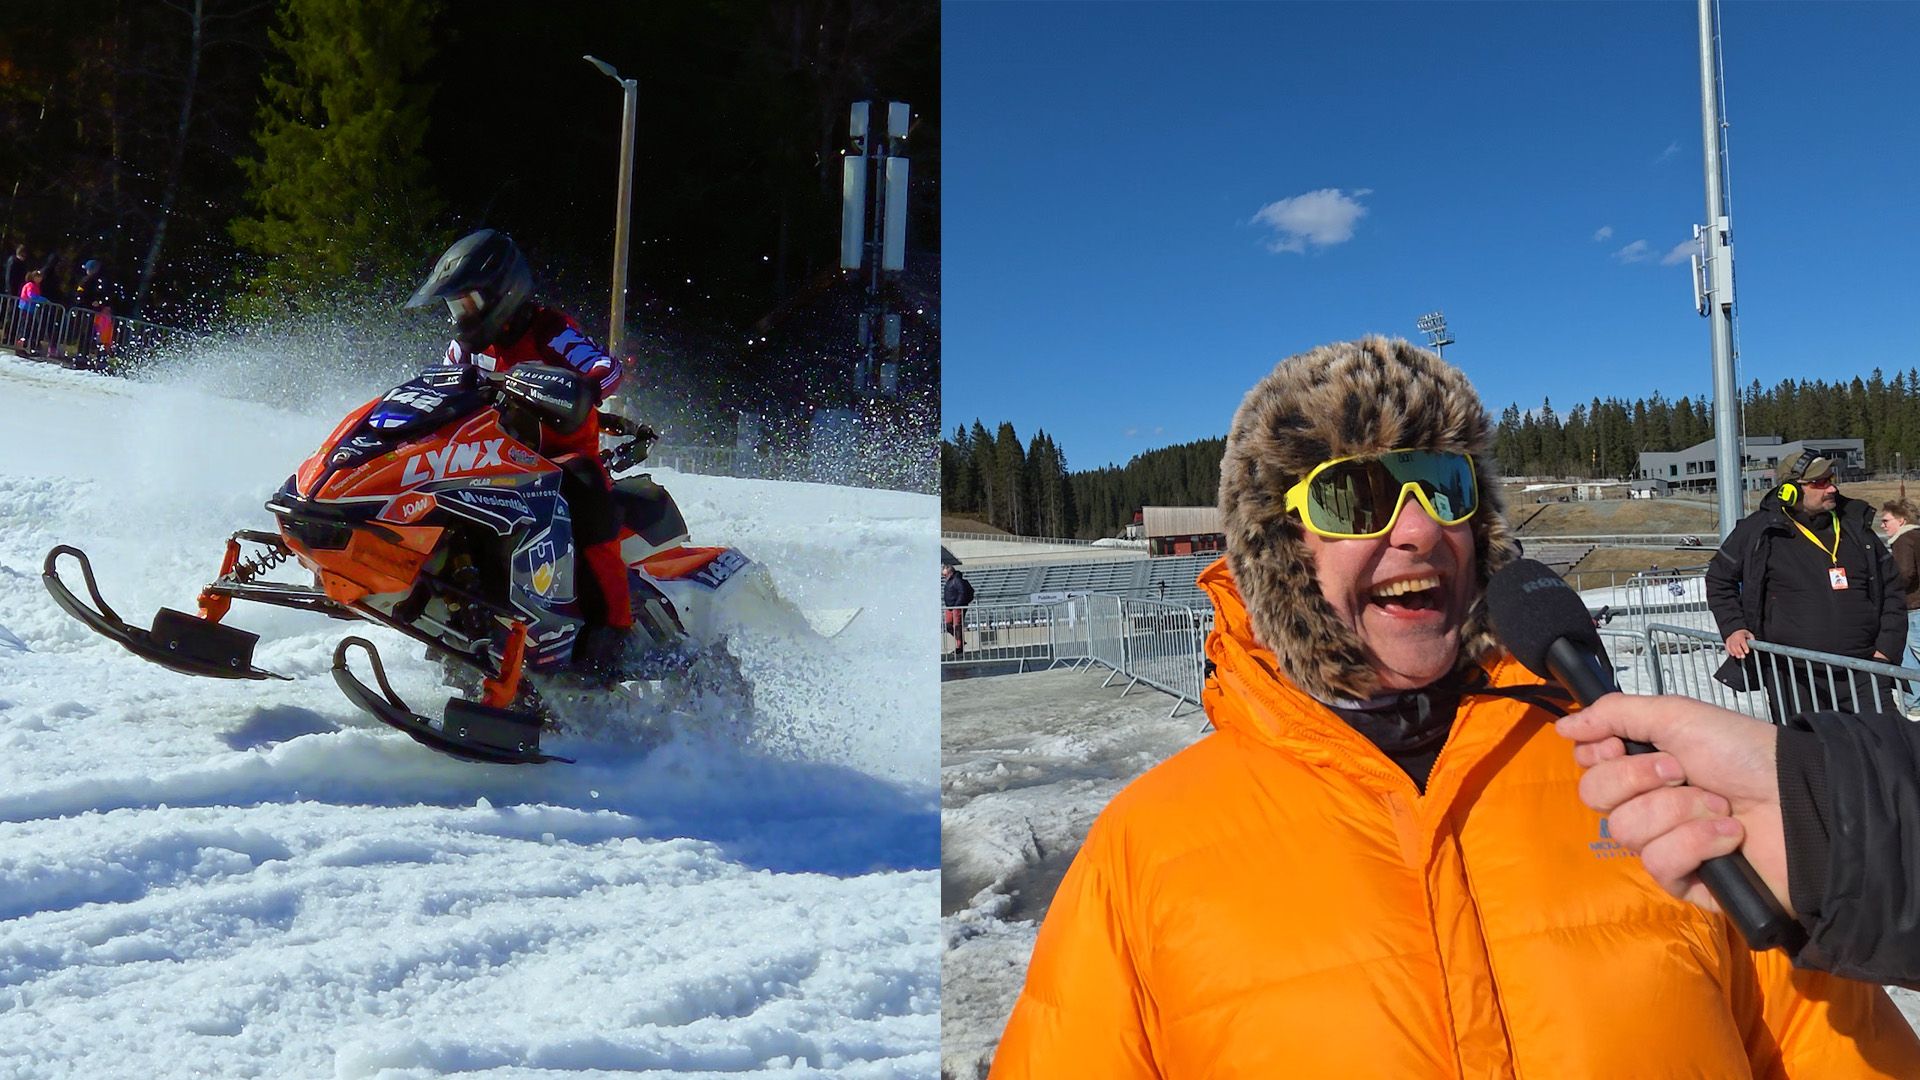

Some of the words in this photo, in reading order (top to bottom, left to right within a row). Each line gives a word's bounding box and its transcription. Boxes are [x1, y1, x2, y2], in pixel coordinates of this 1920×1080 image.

[383, 387, 443, 413] 142
[400, 438, 504, 487] LYNX
[697, 551, 745, 585] 142
